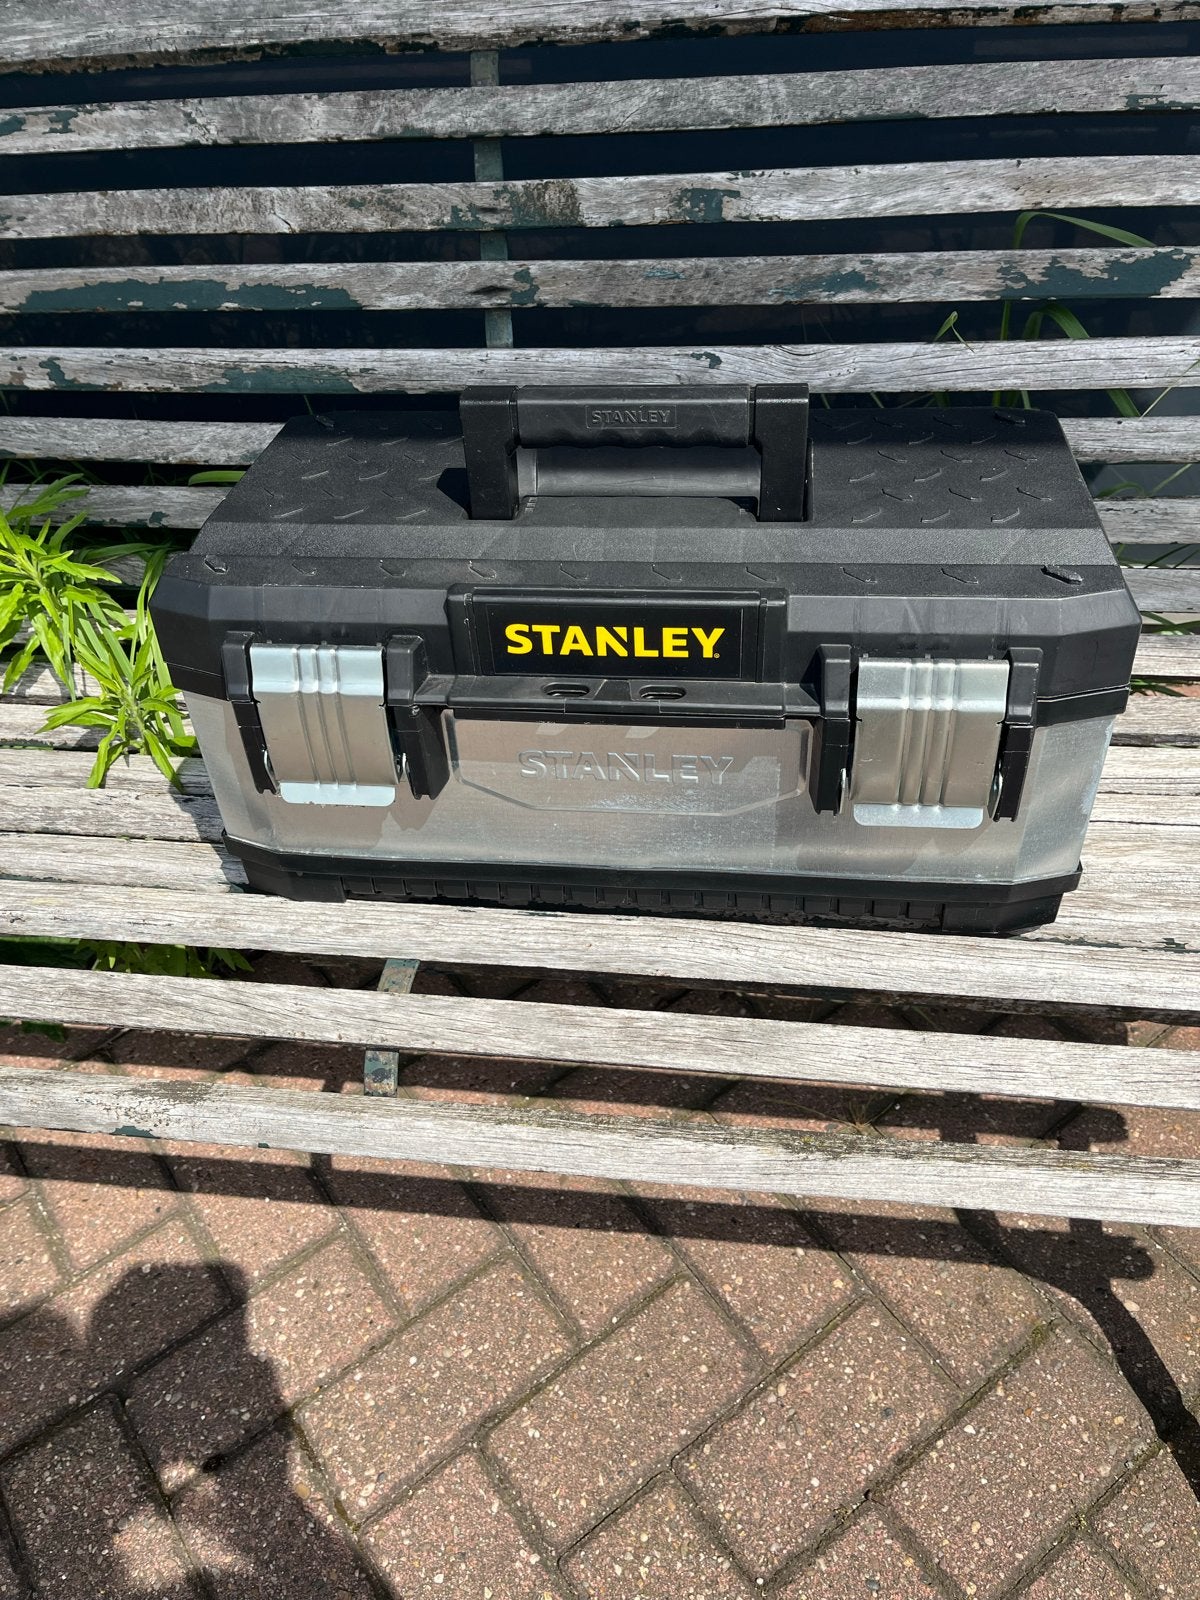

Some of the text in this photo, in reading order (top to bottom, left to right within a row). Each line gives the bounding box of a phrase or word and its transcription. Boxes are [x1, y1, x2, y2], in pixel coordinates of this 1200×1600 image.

[591, 409, 670, 424] STANLEY
[504, 623, 726, 659] STANLEY
[518, 750, 734, 785] STANLEY
